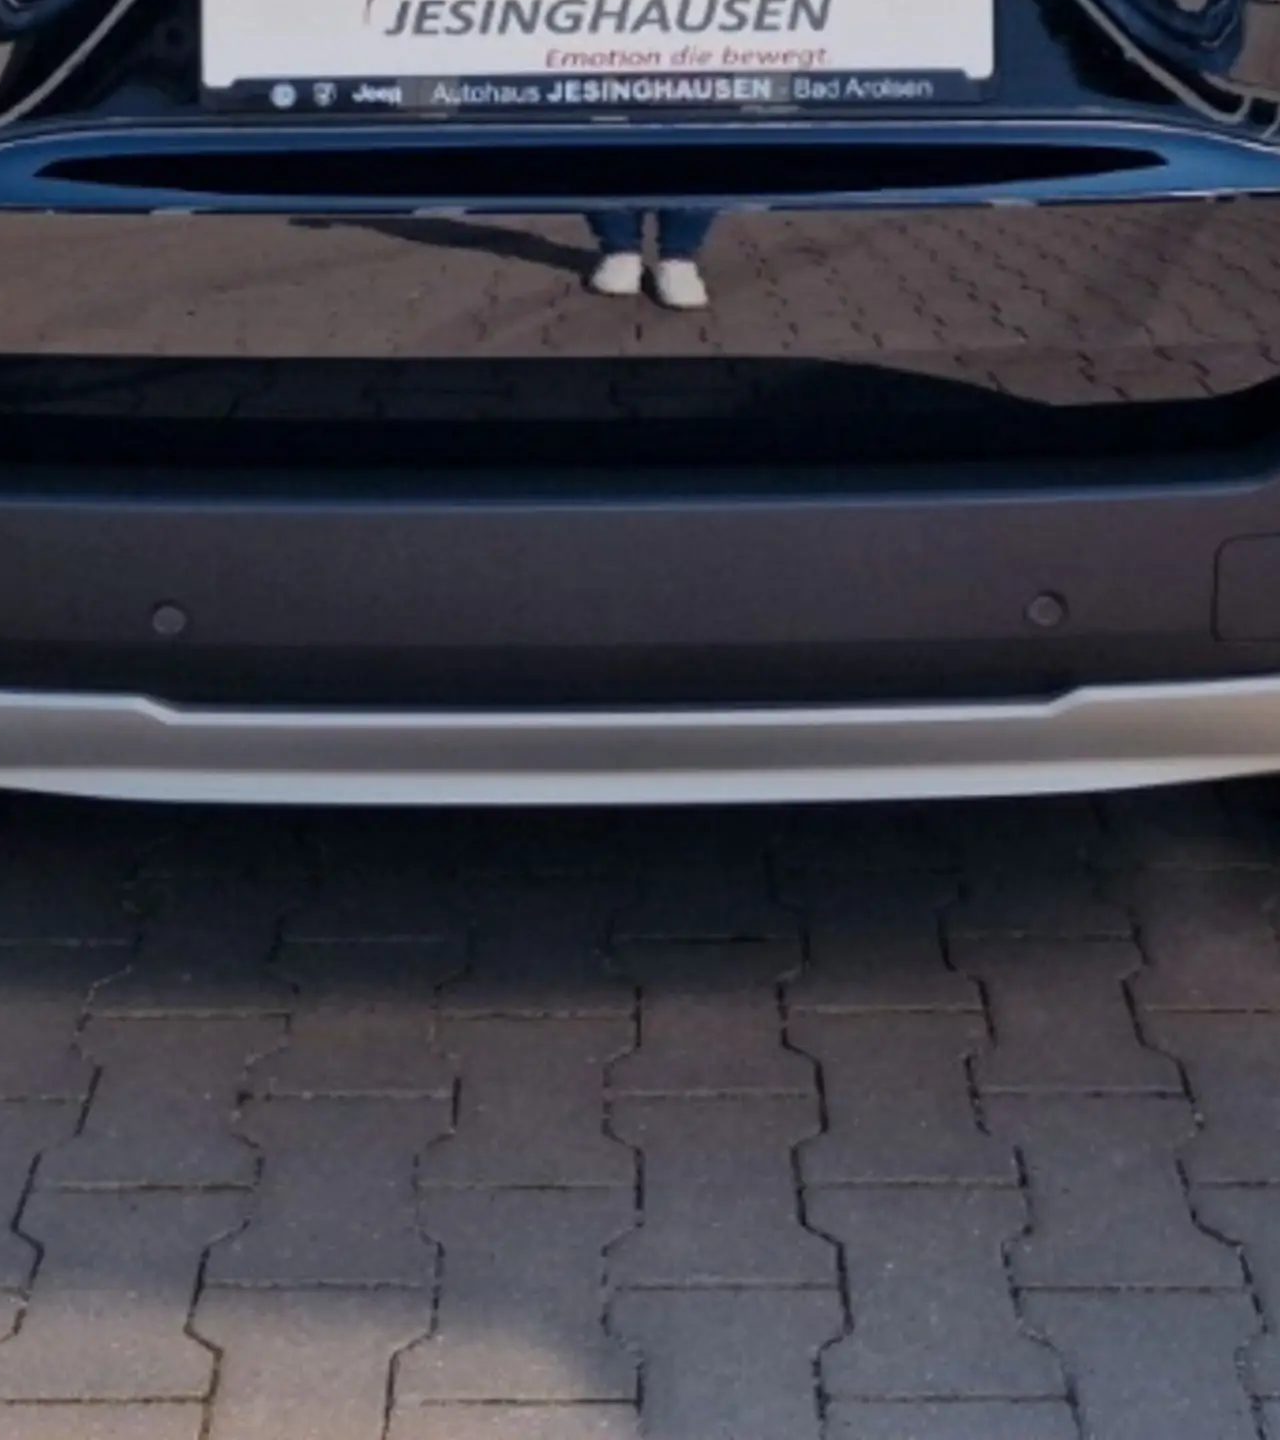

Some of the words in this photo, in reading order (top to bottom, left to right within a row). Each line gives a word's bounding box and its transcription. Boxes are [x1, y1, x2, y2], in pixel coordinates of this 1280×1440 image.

[545, 46, 662, 70] Emotion
[674, 45, 713, 68] die
[430, 81, 541, 104] Autohaus
[546, 77, 770, 103] JESINGHAUSEN
[793, 76, 840, 99] Bad
[845, 76, 934, 100] Arolsen
